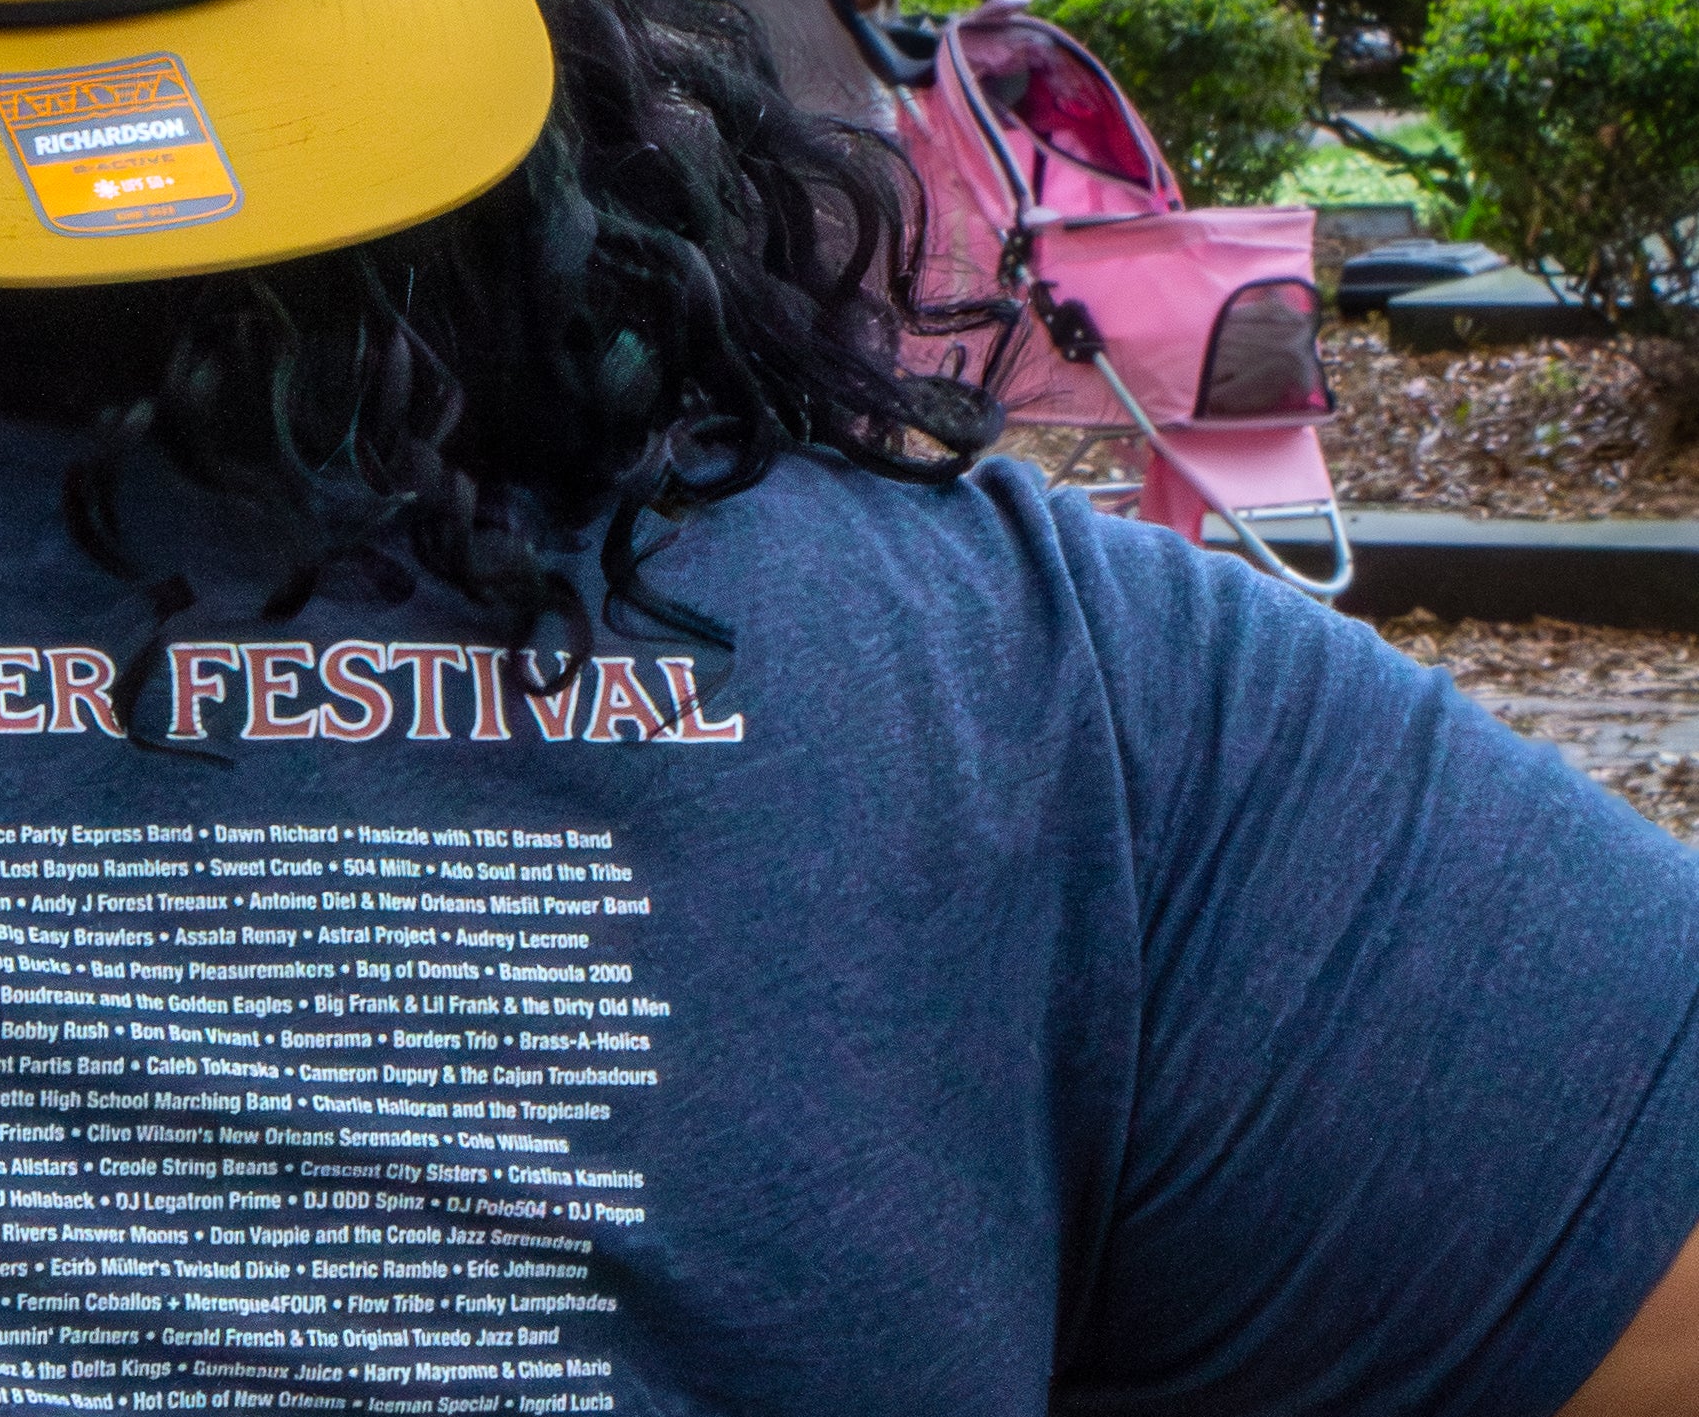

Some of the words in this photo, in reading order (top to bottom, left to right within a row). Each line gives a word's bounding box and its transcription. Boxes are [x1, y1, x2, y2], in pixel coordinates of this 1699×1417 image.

[166, 640, 744, 743] FESTIVAL
[72, 825, 142, 846] Express
[104, 859, 189, 877] Ramblers
[421, 893, 486, 913] Orleans
[375, 926, 436, 947] Project
[589, 964, 632, 983] 2000
[1, 985, 95, 1005] Boudreaux
[554, 998, 594, 1019] Dirty
[2, 1021, 58, 1043] Bobby
[520, 1032, 650, 1051] Brass-A-Holics
[299, 1064, 377, 1082] Cameron
[377, 1098, 448, 1117] Halloran
[0, 1123, 64, 1141] Friends
[163, 1158, 216, 1178] String
[10, 1190, 95, 1209] Hollaback
[3, 1223, 57, 1241] Rivers
[384, 1260, 448, 1278] Ramble
[343, 1329, 409, 1351] Original
